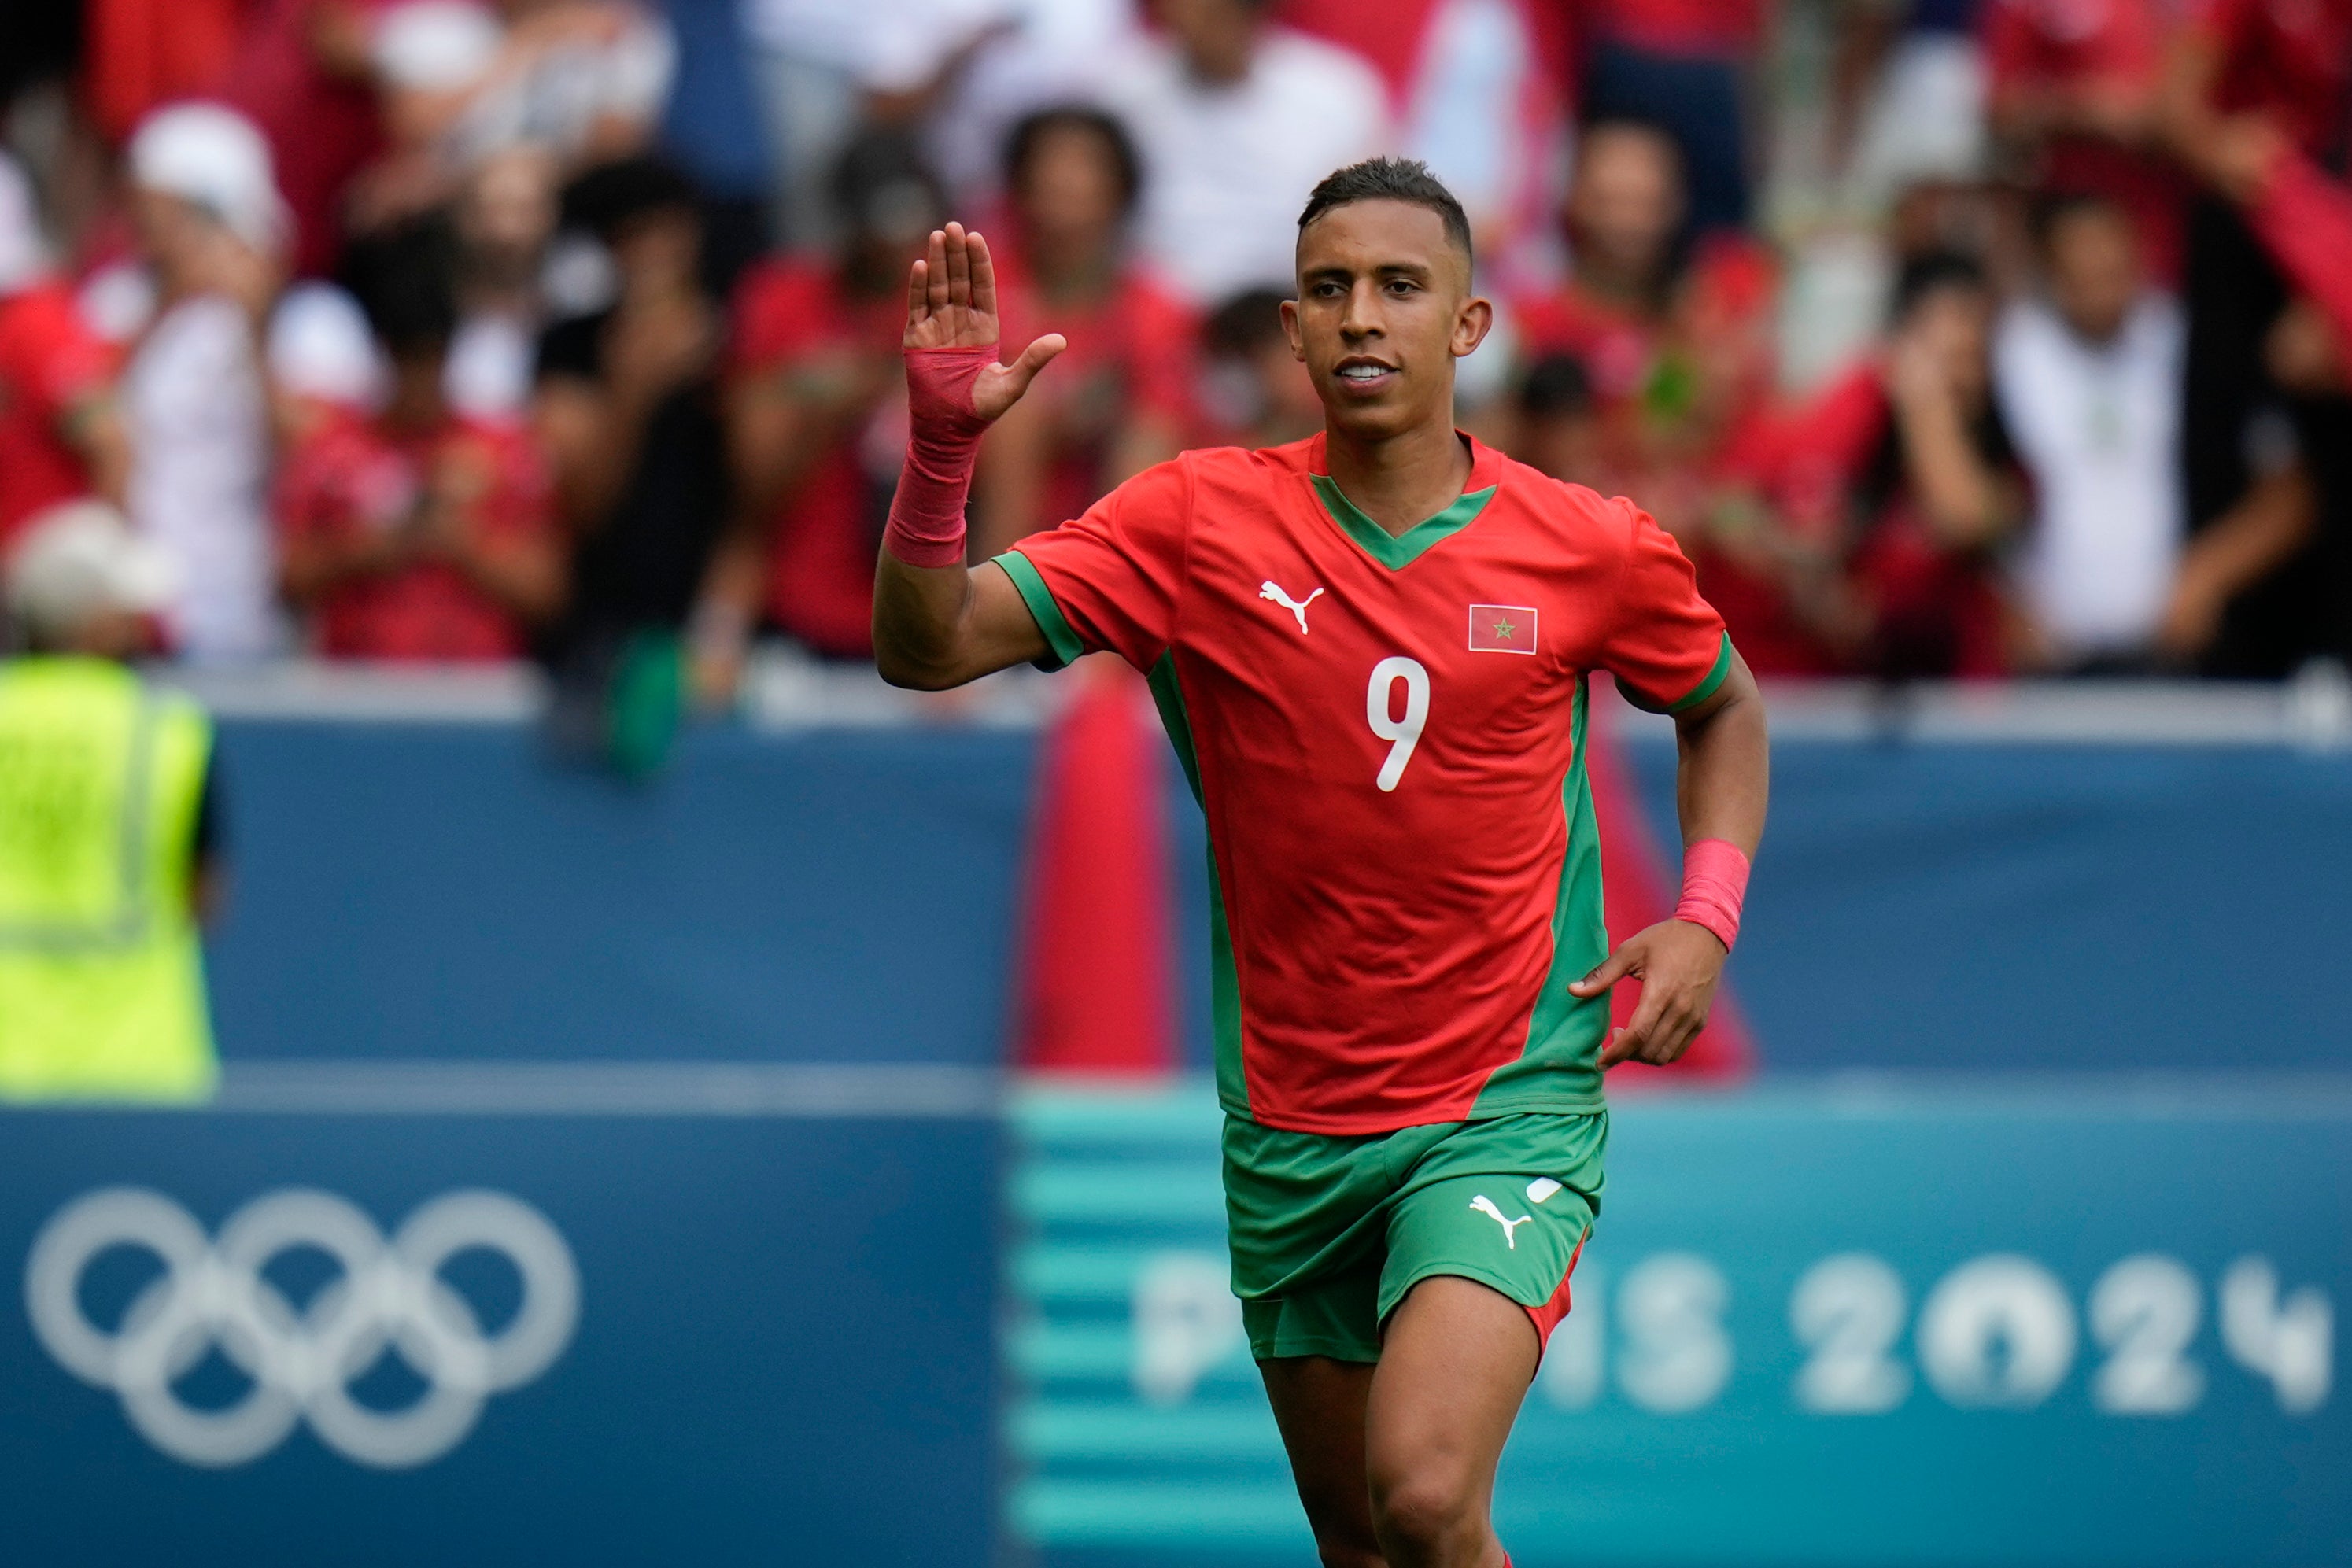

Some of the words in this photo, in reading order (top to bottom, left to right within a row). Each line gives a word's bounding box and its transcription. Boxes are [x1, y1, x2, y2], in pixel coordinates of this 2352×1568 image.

[1366, 655, 1431, 793] 9
[1133, 1253, 1733, 1413] PIS
[1792, 1253, 2333, 1414] 2024
